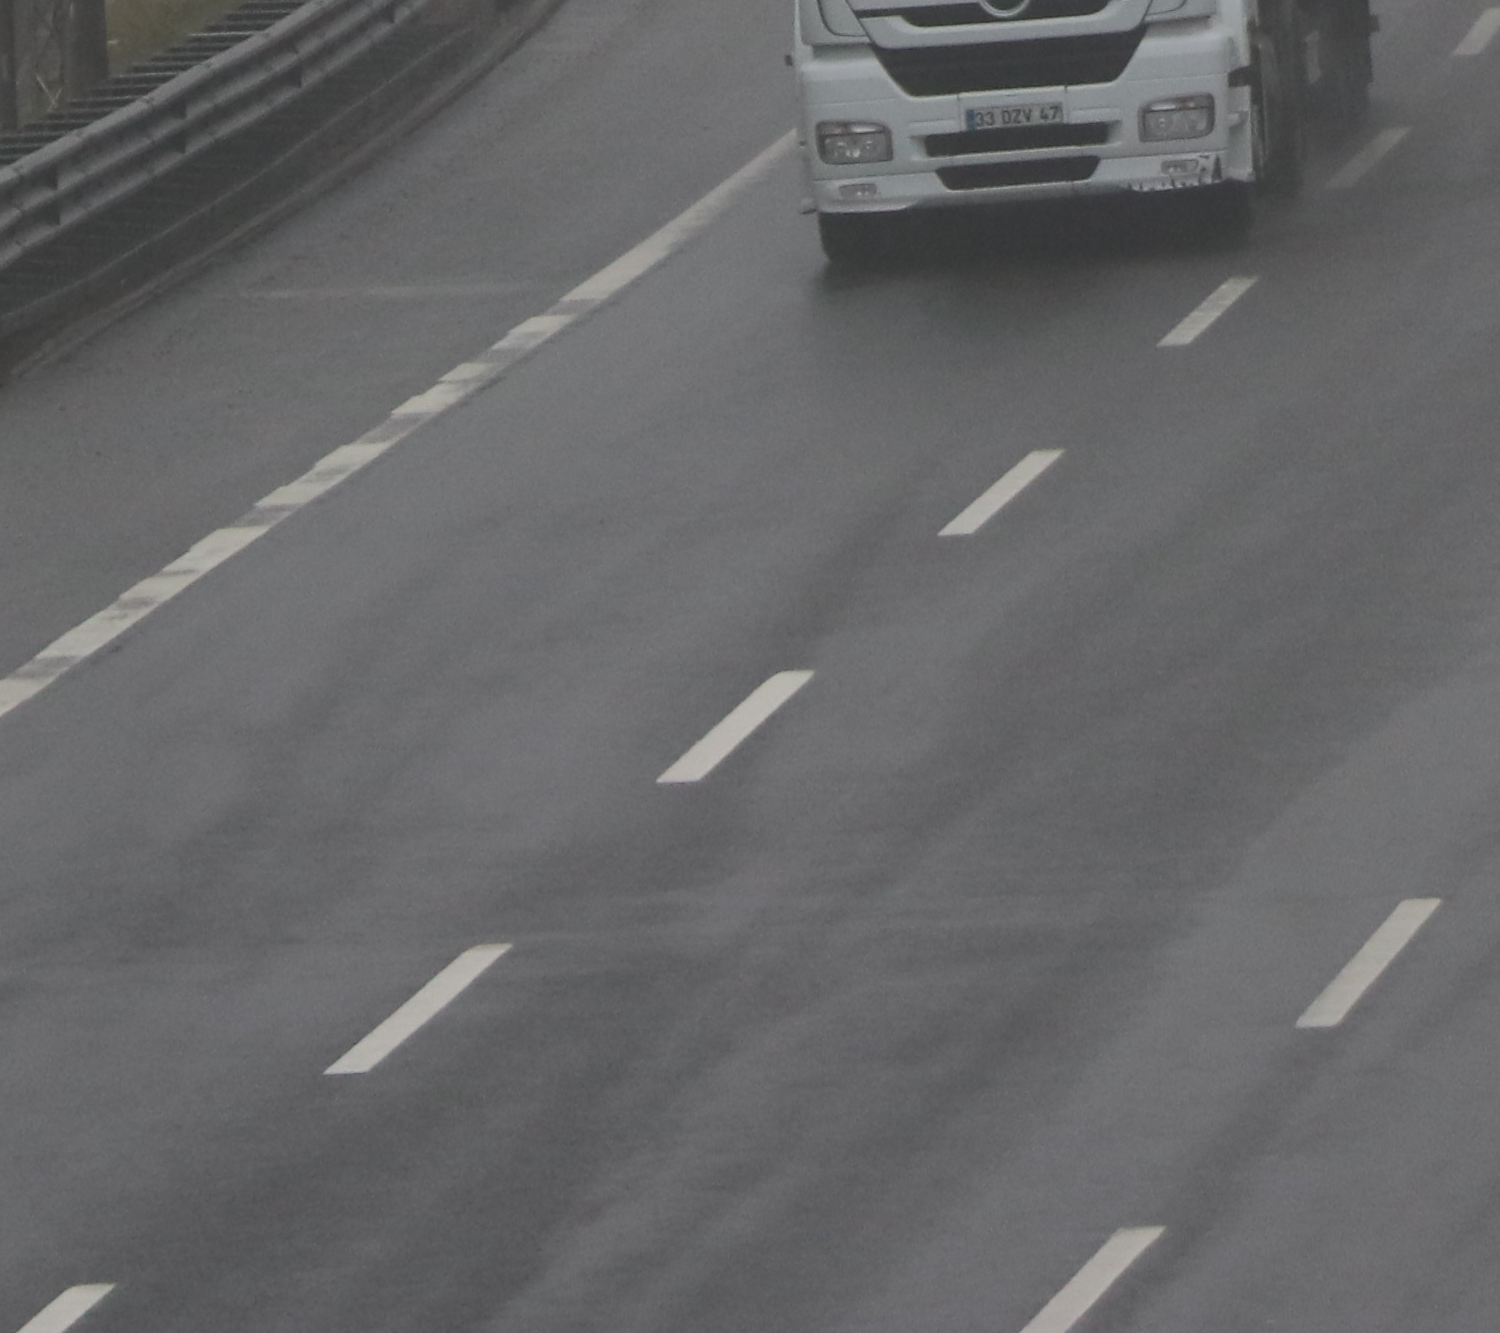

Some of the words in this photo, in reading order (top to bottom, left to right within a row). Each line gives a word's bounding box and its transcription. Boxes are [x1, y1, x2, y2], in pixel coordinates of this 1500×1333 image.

[975, 111, 995, 126] 33
[1001, 108, 1032, 125] DZV
[1039, 105, 1060, 121] 47
